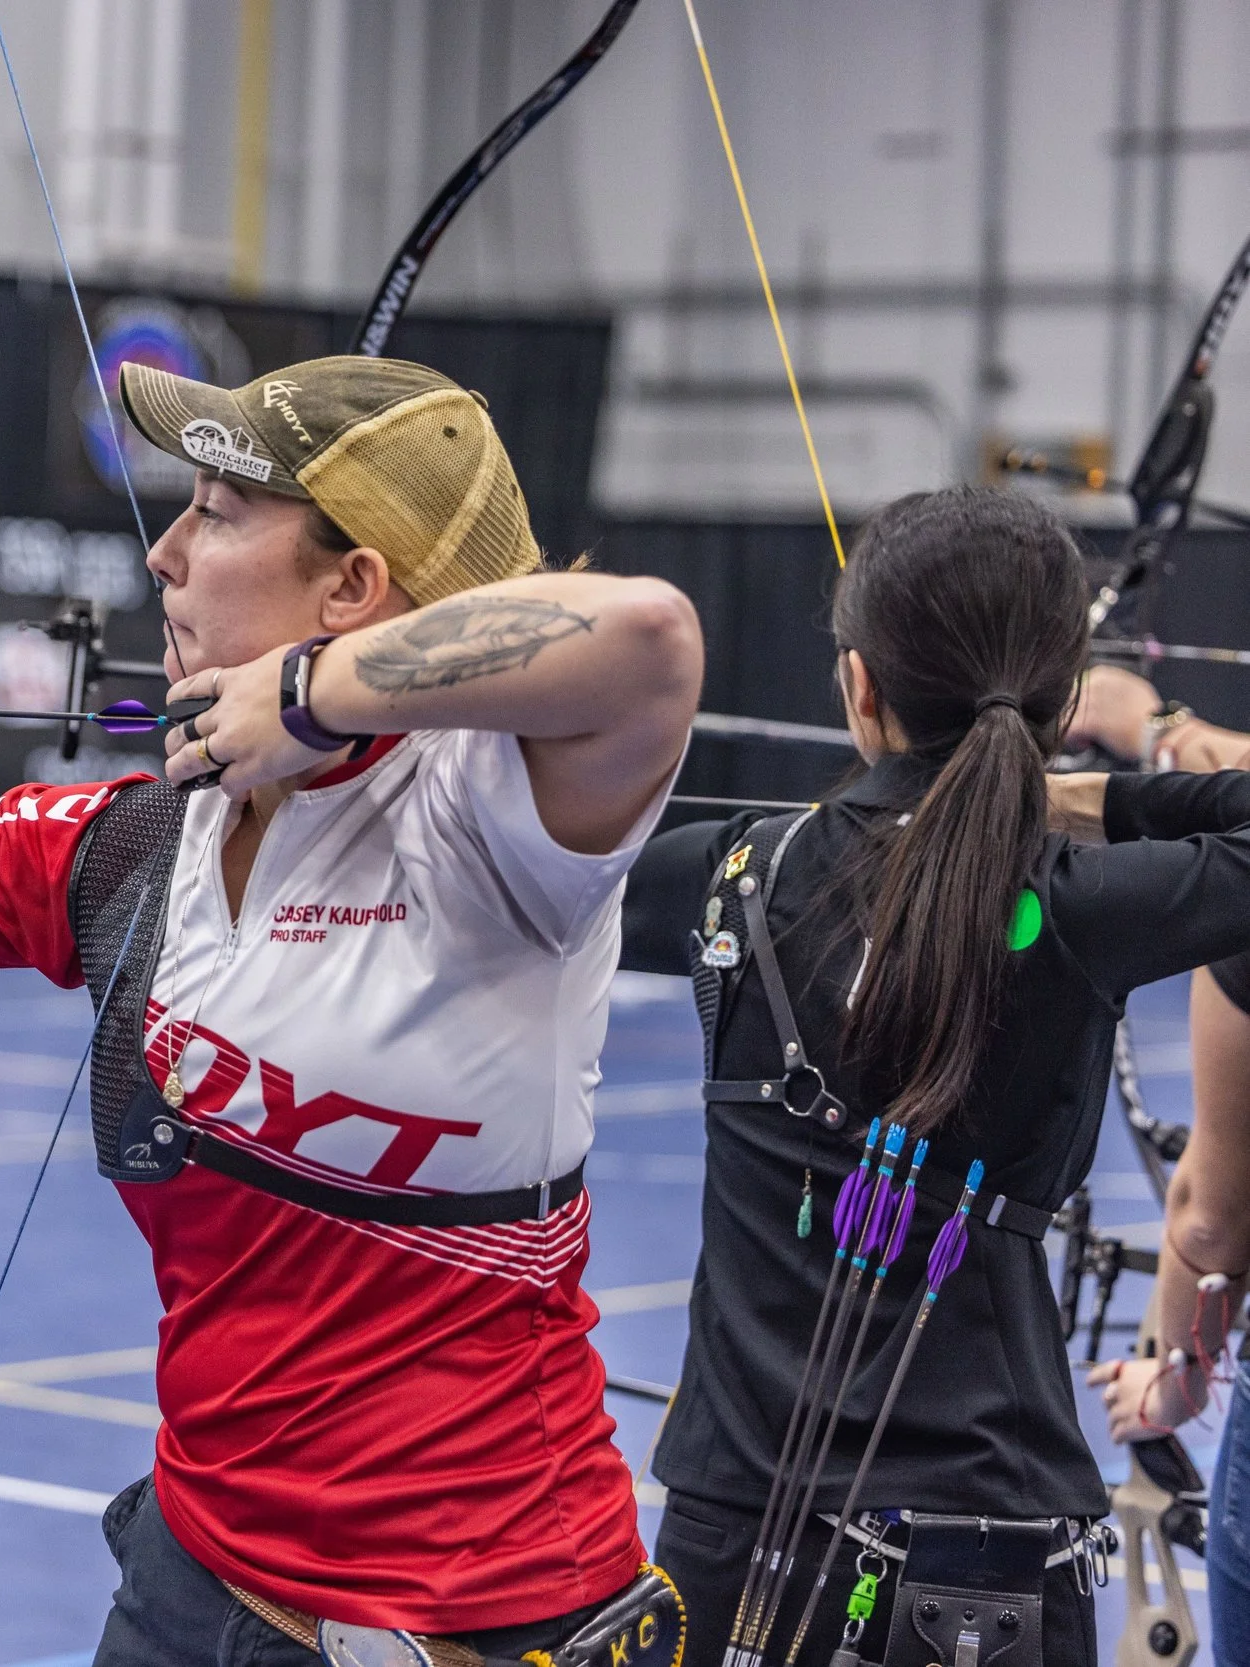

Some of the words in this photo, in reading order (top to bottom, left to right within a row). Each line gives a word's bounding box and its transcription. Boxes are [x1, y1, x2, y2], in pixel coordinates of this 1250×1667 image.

[276, 400, 313, 443] HOYT
[196, 453, 235, 470] ARCHERY
[235, 465, 266, 480] SUPPLY
[200, 441, 269, 473] Lancaster
[273, 904, 326, 924] CASEY
[269, 929, 290, 942] PRO
[291, 929, 327, 943] STAFF
[144, 996, 483, 1186] OYT
